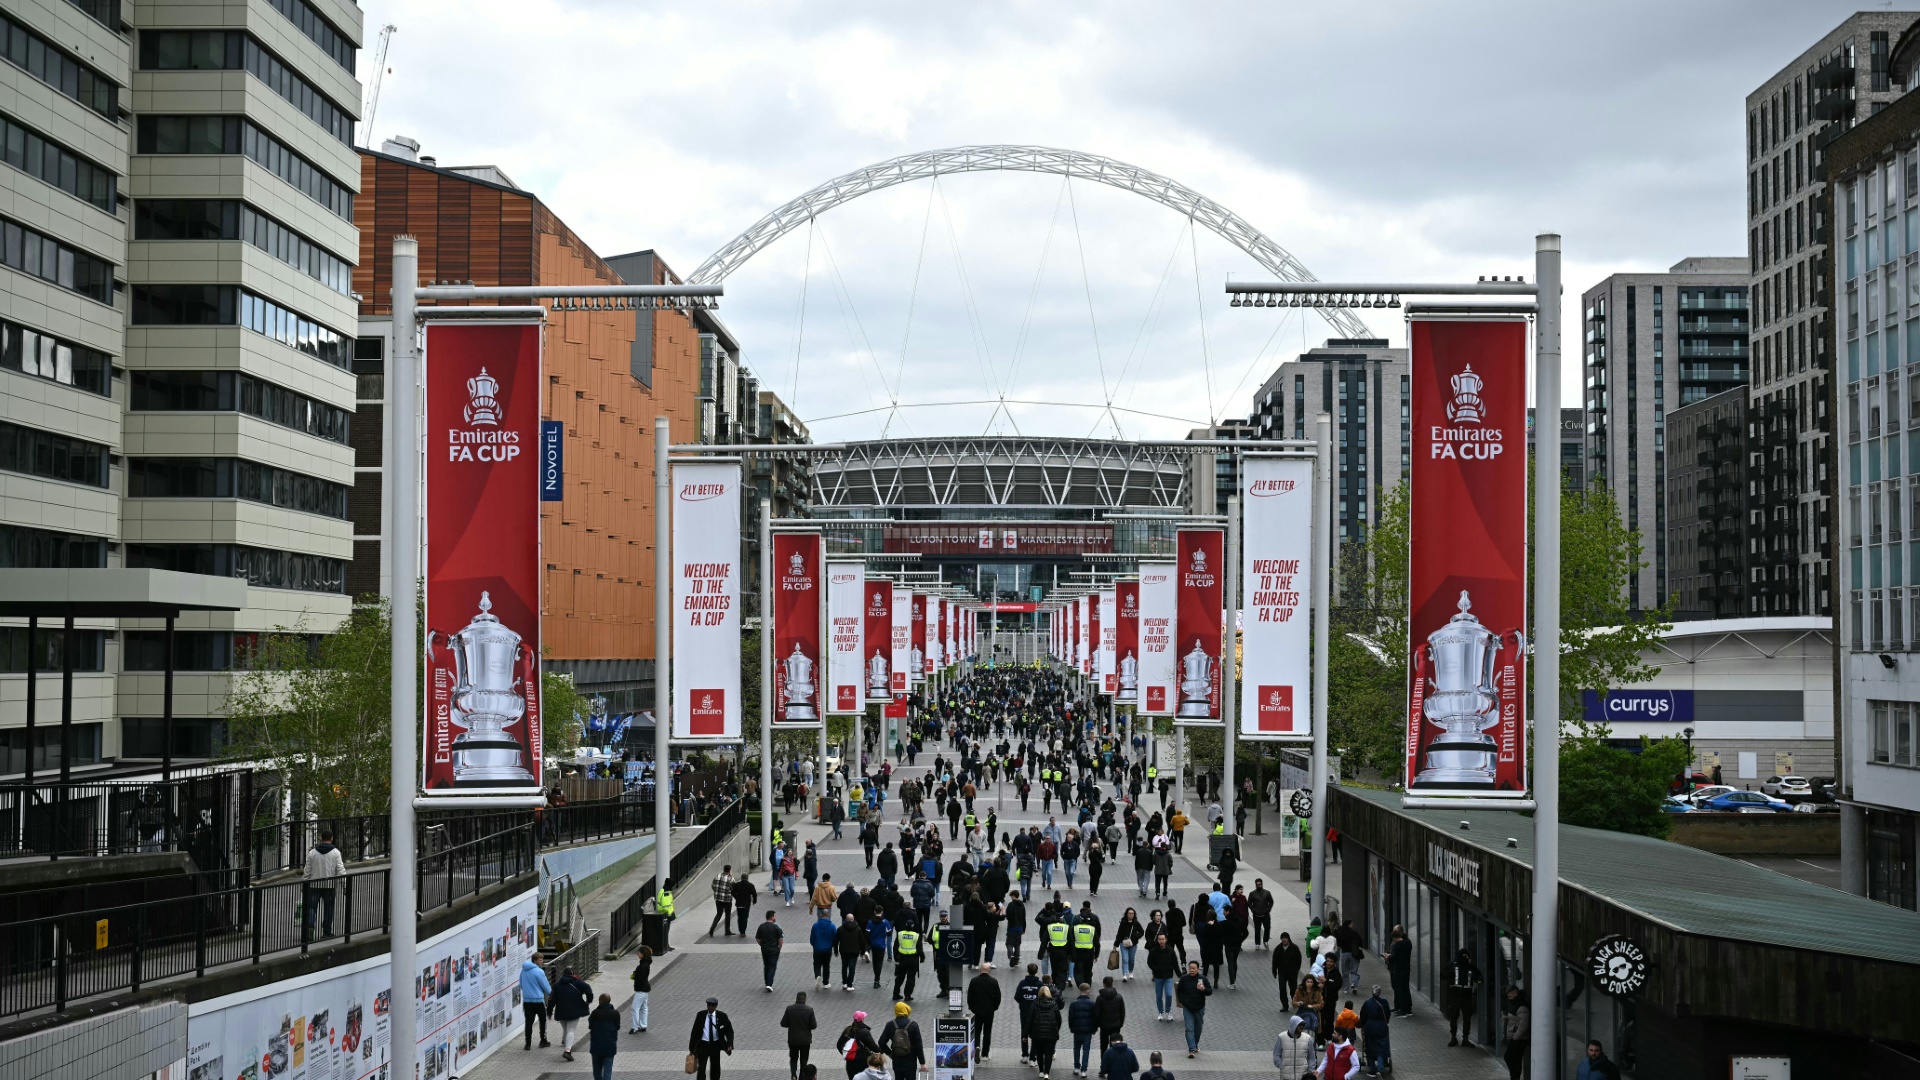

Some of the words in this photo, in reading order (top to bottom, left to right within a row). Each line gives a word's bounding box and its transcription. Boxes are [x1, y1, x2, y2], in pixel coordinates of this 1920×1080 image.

[448, 428, 520, 444] Emirates
[1431, 425, 1503, 441] Emirates
[449, 445, 474, 462] FA
[477, 444, 521, 462] CUP
[545, 426, 557, 490] NOVOTEL
[1431, 443, 1456, 459] FA
[1459, 442, 1503, 460] CUP
[684, 484, 696, 495] FLY
[698, 484, 724, 495] BETTER
[1254, 480, 1266, 491] FLY
[1268, 480, 1295, 490] BETTER
[910, 536, 943, 544] LUTON
[945, 536, 976, 544] TOWN
[982, 535, 990, 545] 2
[1005, 534, 1014, 545] 6
[1021, 536, 1085, 545] MANCHESTER
[1087, 537, 1108, 545] CITY
[684, 563, 730, 578] WELCOME
[1253, 560, 1300, 574] WELCOME
[692, 580, 702, 594] TO
[706, 580, 723, 594] THE
[1260, 576, 1271, 590] TO
[1275, 576, 1292, 590] THE
[684, 596, 730, 610] EMIRATES
[1252, 592, 1300, 606] EMIRATES
[690, 612, 702, 626] FA
[705, 612, 724, 626] CUP
[834, 617, 859, 626] WELCOME
[1144, 618, 1170, 626] WELCOME
[1258, 608, 1270, 622] FA
[1272, 608, 1294, 622] CUP
[838, 626, 844, 634] TO
[846, 626, 855, 634] THE
[1148, 627, 1154, 635] TO
[1156, 627, 1165, 635] THE
[834, 634, 859, 643] EMIRATES
[1144, 636, 1170, 644] EMIRATES
[837, 644, 844, 652] FA
[844, 644, 856, 652] CUP
[1147, 644, 1154, 652] FA
[1154, 644, 1166, 652] CUP
[435, 668, 446, 689] BETTER
[1504, 665, 1515, 687] BETTER
[436, 689, 448, 700] FLY
[526, 681, 536, 700] BETTER
[1414, 677, 1424, 698] BETTER
[1503, 686, 1516, 700] FLY
[528, 700, 536, 712] FLY
[1260, 704, 1290, 712] Emirates
[1412, 700, 1421, 710] FLY
[1610, 698, 1670, 716] currys
[435, 704, 450, 764] Emirates
[530, 714, 541, 761] Emirates
[1408, 711, 1420, 757] Emirates
[1500, 703, 1515, 762] Emirates
[1428, 842, 1444, 879] BLACK
[1444, 848, 1458, 886] SHEEP
[1458, 856, 1480, 898] COFFEE
[1594, 944, 1614, 976] BLACK
[1614, 940, 1644, 960] SHEEP
[1608, 970, 1645, 994] COFFEE
